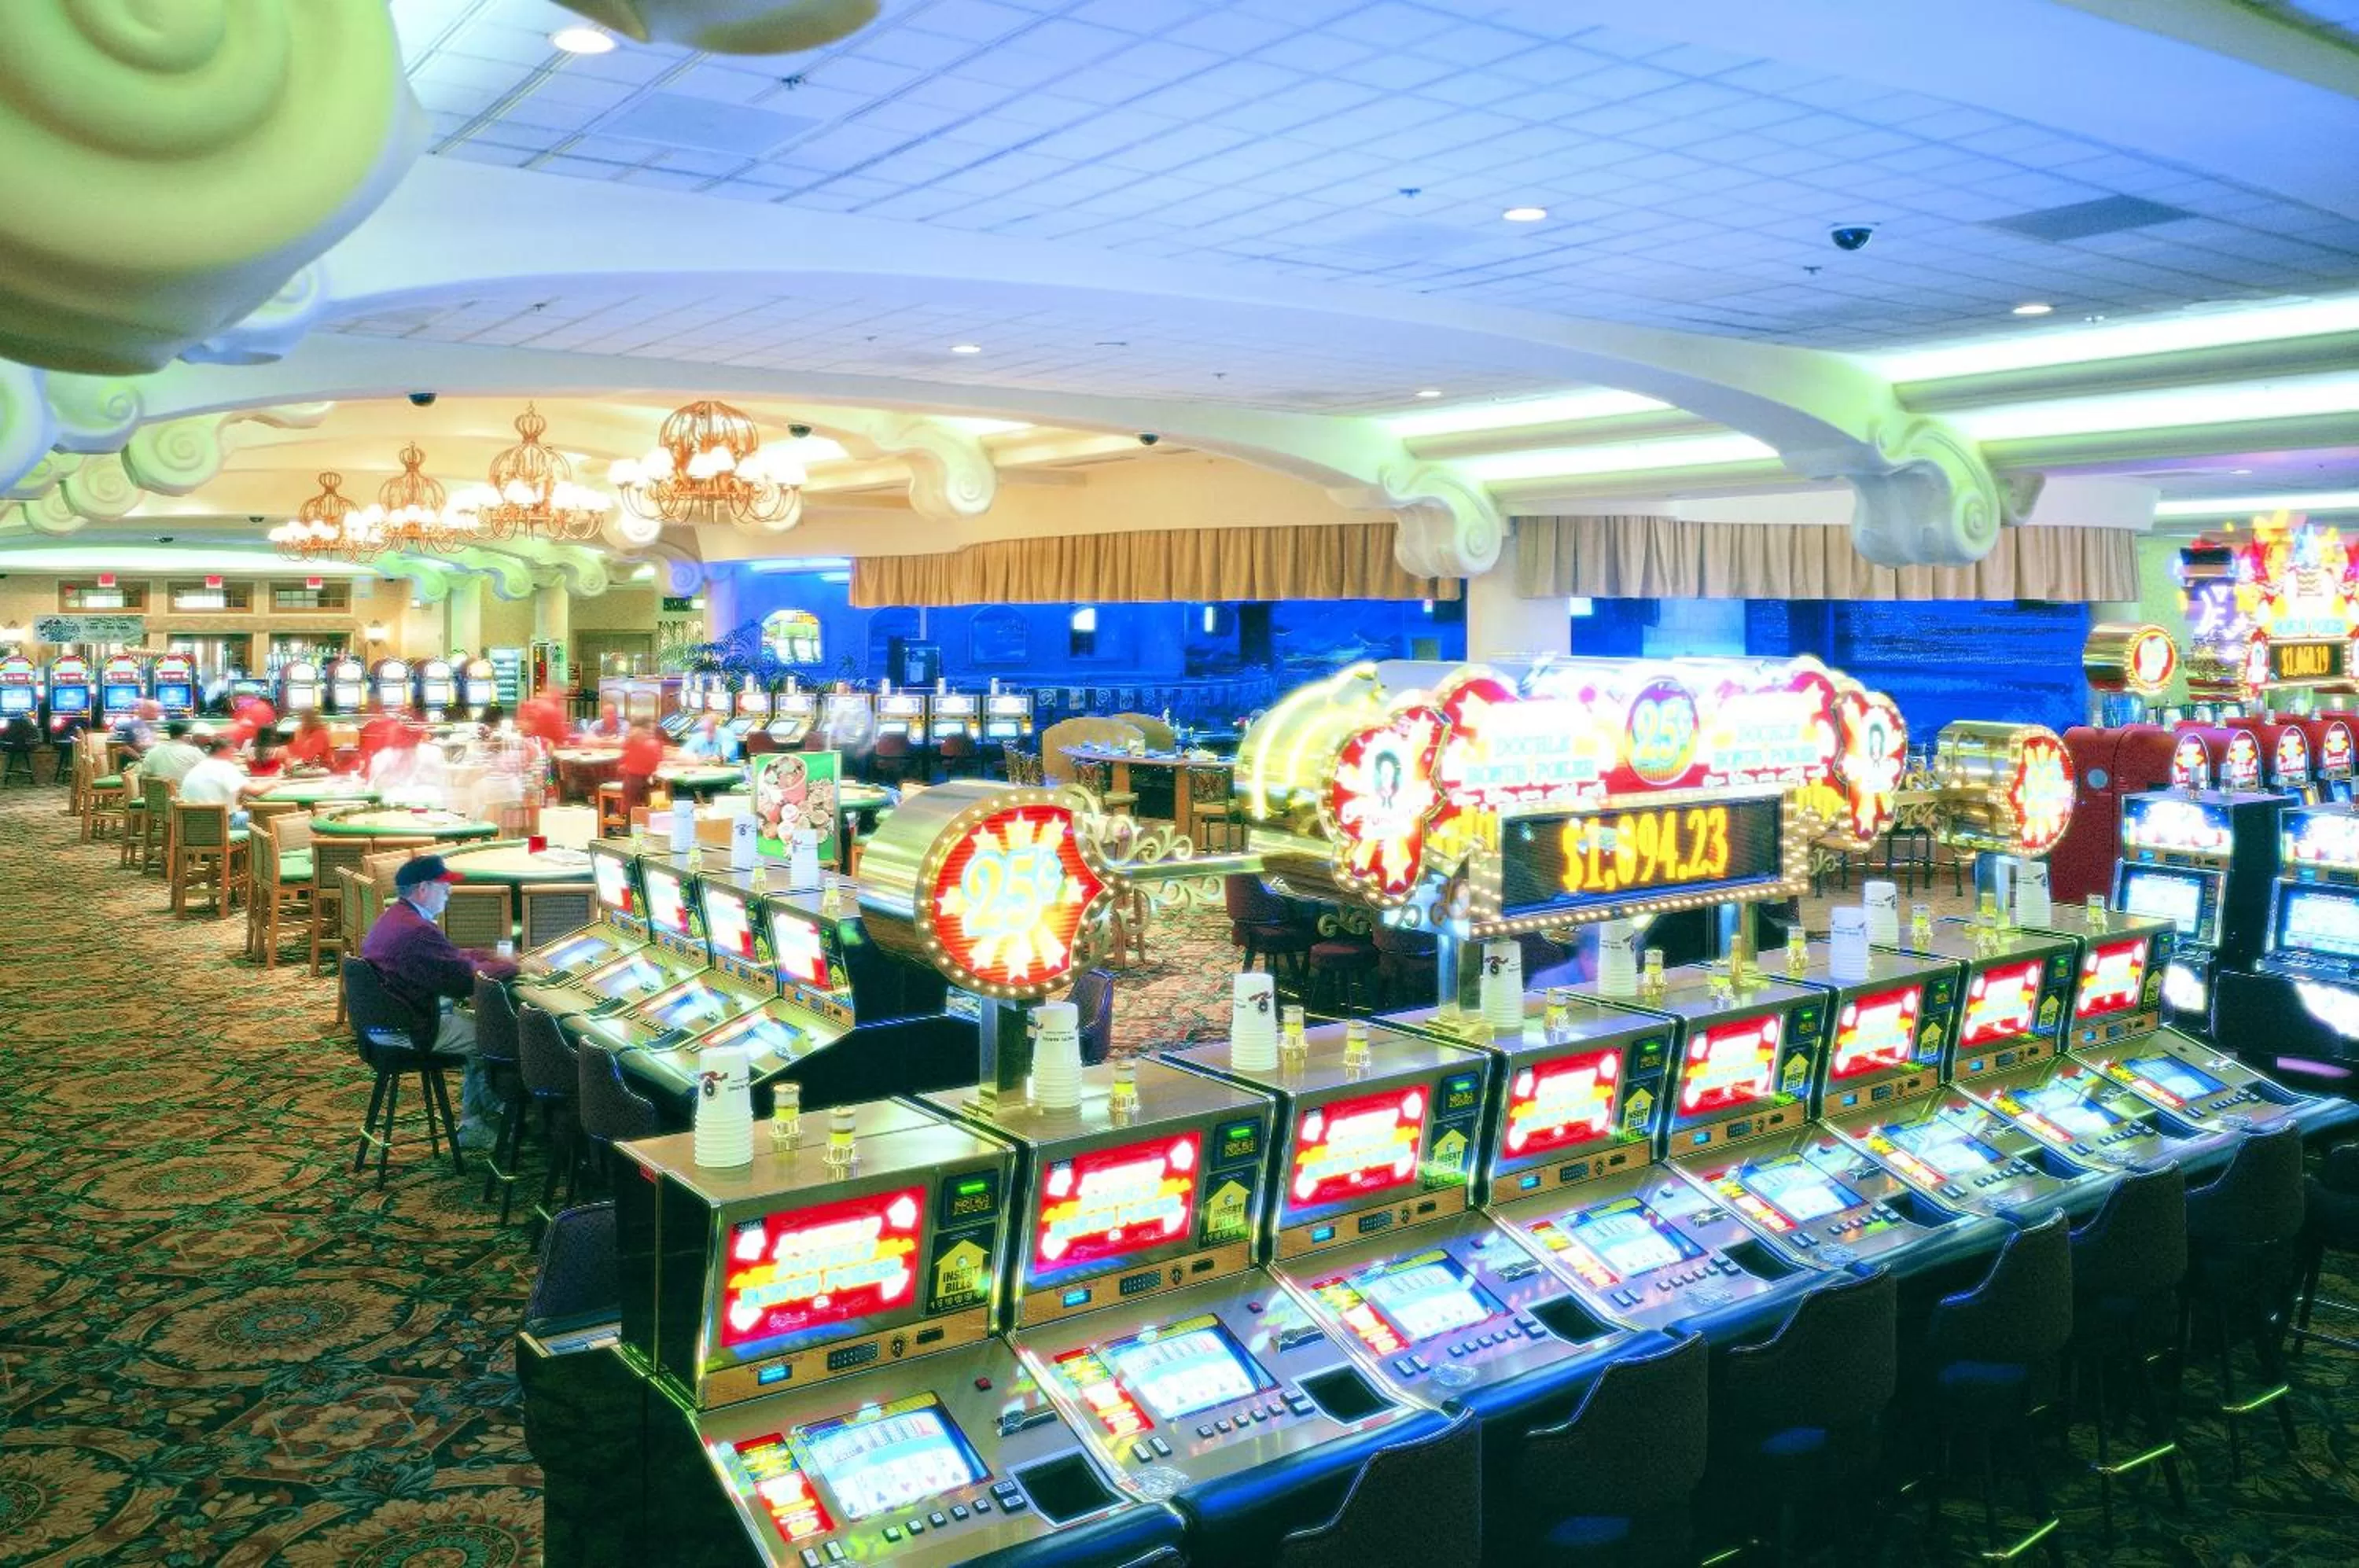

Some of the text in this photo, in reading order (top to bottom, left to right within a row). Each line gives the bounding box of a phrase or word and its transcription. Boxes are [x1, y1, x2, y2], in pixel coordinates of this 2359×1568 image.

[1562, 806, 1728, 892] $1,094.23
[964, 849, 1060, 934] 25¢
[944, 1264, 980, 1283] INSERT
[945, 1280, 972, 1294] BILLS
